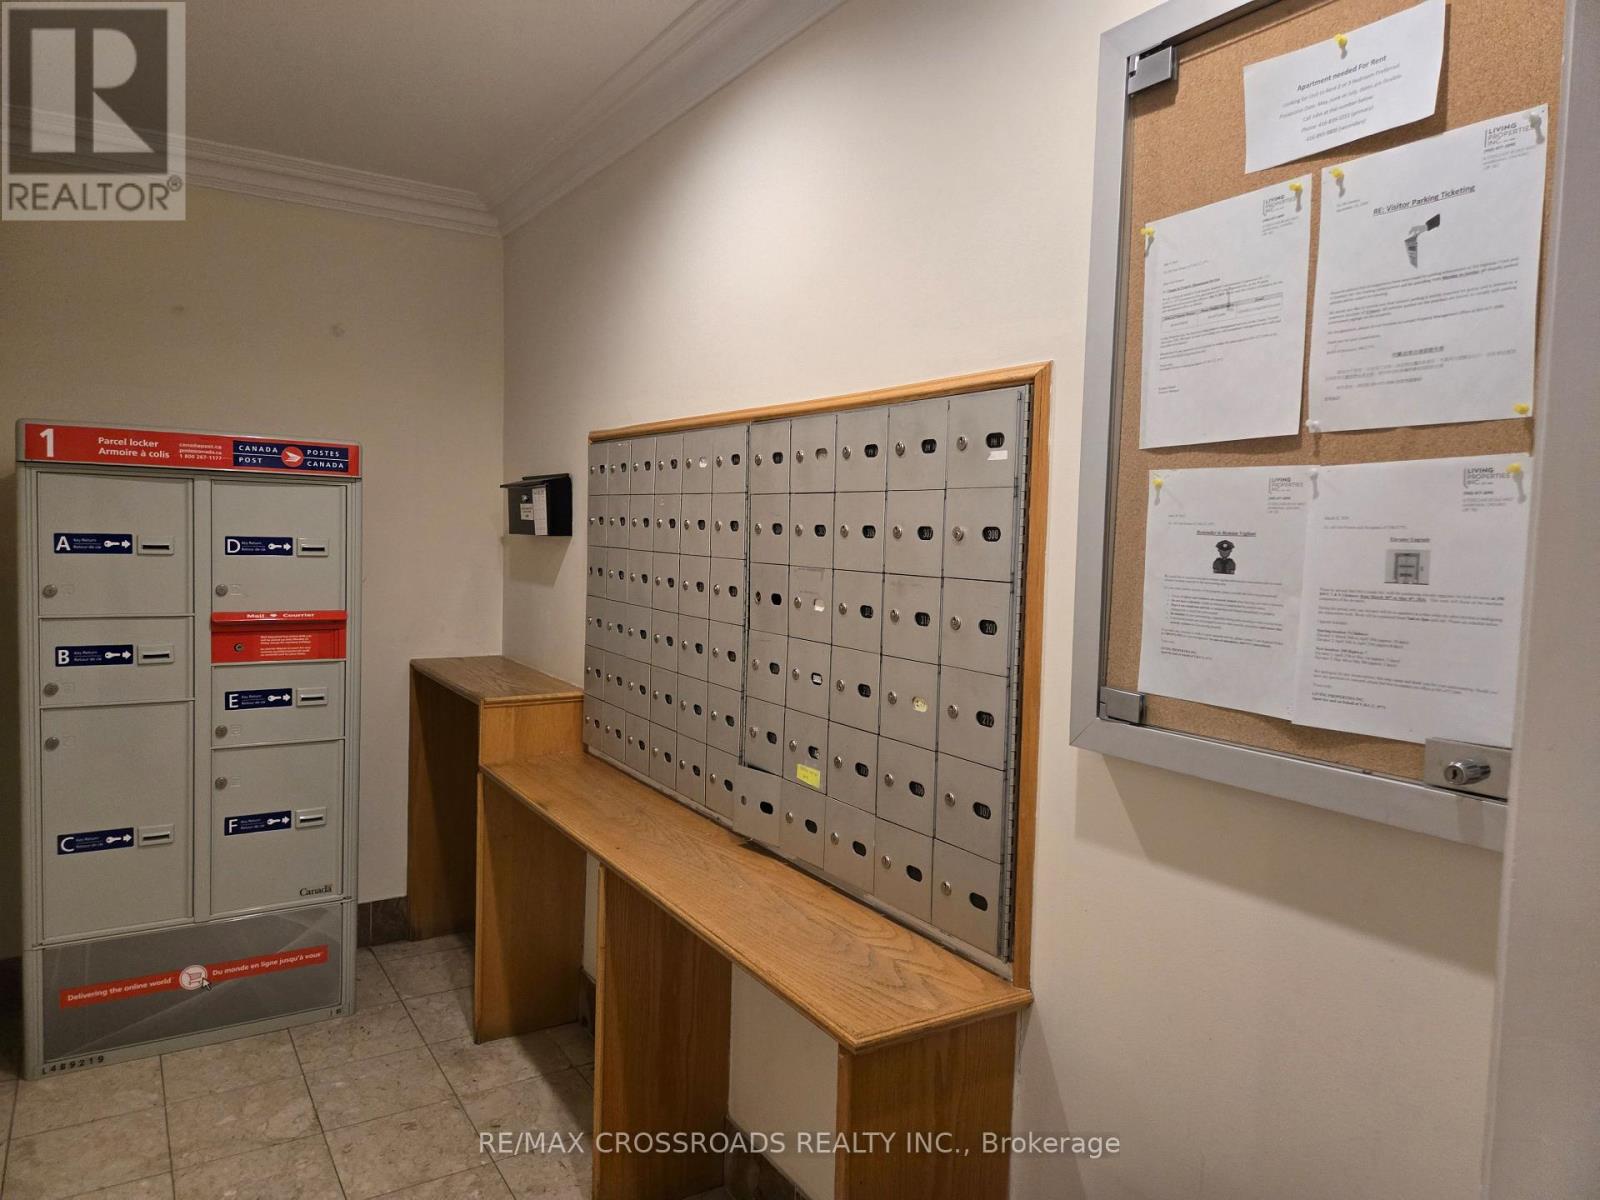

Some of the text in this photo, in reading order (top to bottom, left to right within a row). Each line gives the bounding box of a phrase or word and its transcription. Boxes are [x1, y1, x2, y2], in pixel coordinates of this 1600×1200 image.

[1297, 55, 1387, 91] Apartment needed For Rent
[1488, 122, 1517, 135] LIVING
[1373, 206, 1385, 217] RE:
[1386, 198, 1410, 214] Visitor
[1411, 190, 1439, 209] Parking
[1440, 183, 1475, 203] Ticketing
[39, 428, 55, 458] 1
[98, 436, 159, 449] Parcel locker
[238, 444, 279, 454] CANADA
[98, 447, 170, 459] Armoire à colis
[238, 456, 263, 464] POST
[307, 449, 340, 458] POSTES
[306, 460, 344, 470] CANADA
[1467, 466, 1495, 475] LIVING
[55, 535, 71, 551] A
[227, 538, 241, 554] D
[57, 649, 70, 665] B
[229, 693, 239, 709] E
[229, 818, 239, 833] F
[60, 836, 75, 852] C
[299, 884, 332, 897] Canada
[212, 968, 223, 976] Du
[224, 963, 249, 974] monde
[261, 959, 278, 968] ligne
[279, 954, 304, 966] jusqu'à
[305, 951, 321, 960] vous
[67, 977, 172, 1001] Delivering the online world
